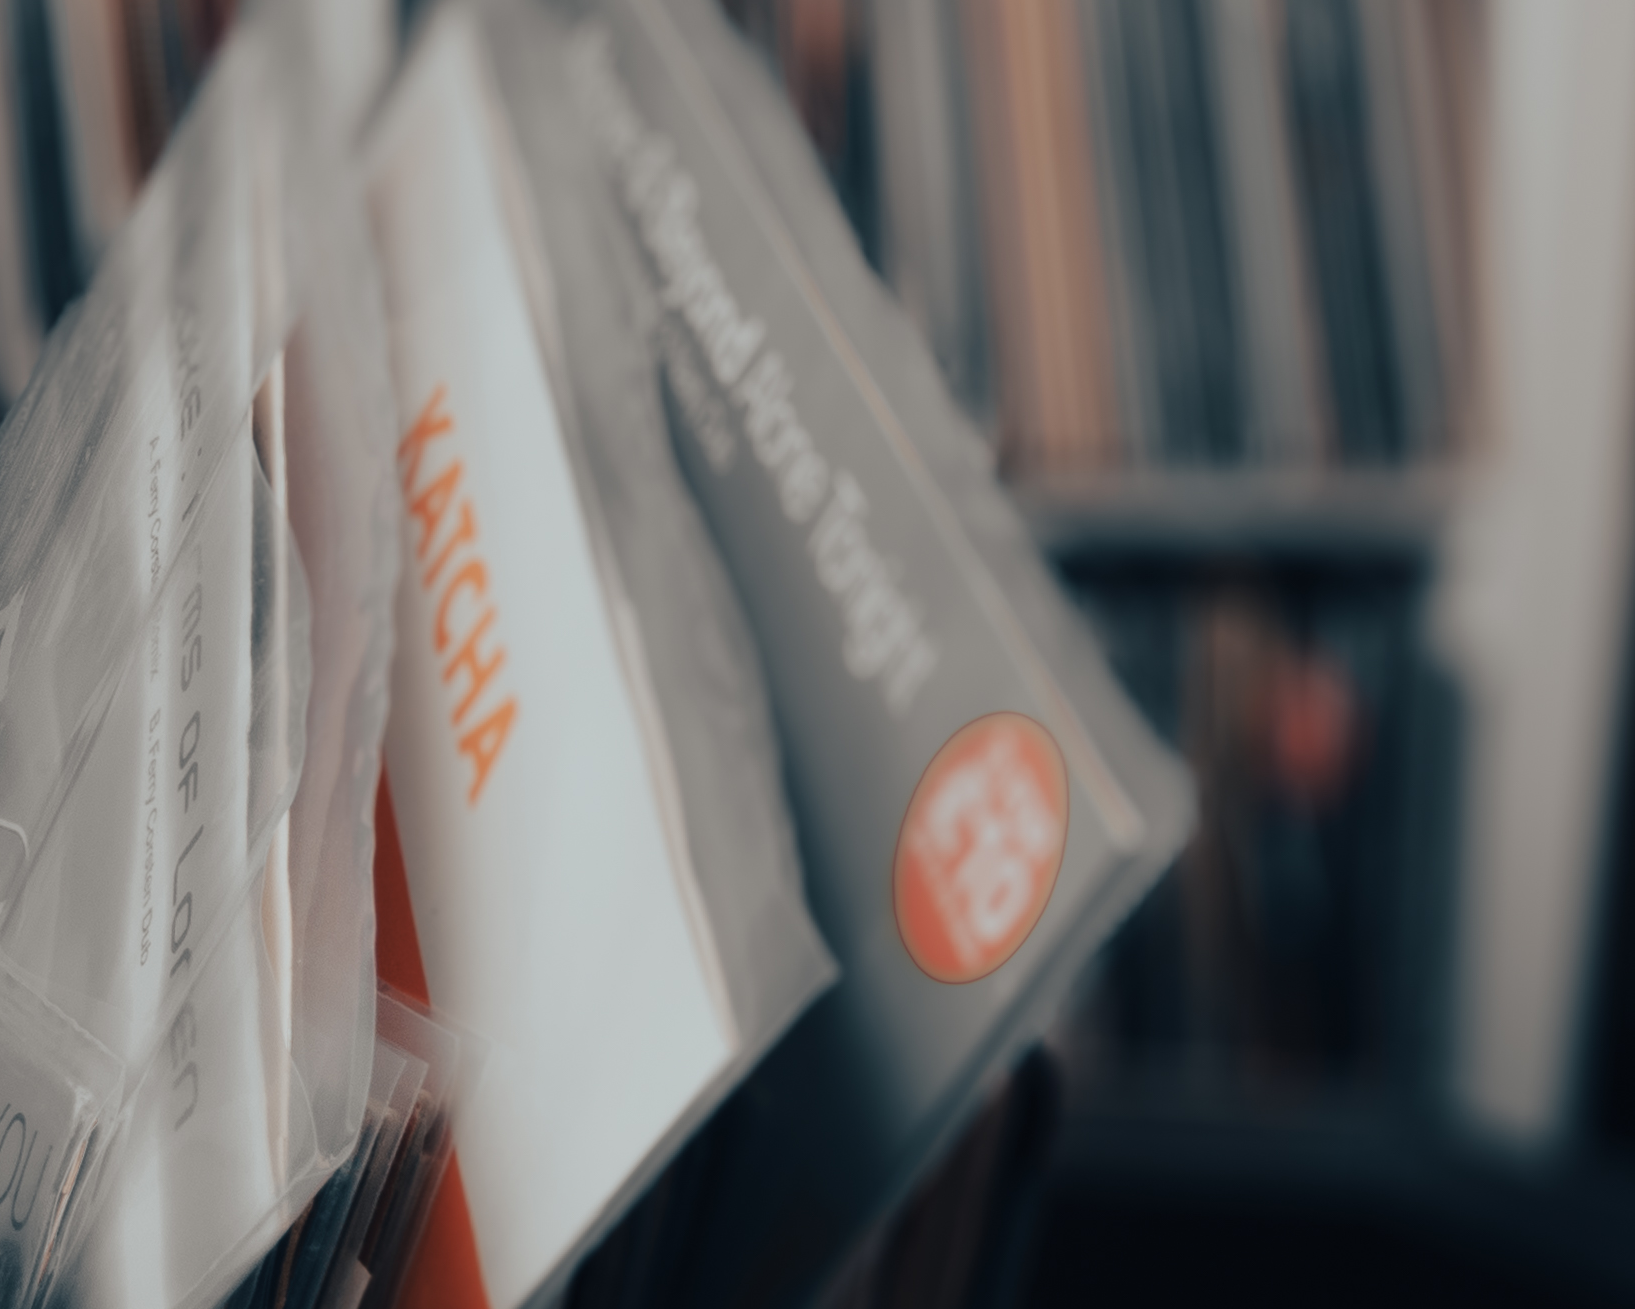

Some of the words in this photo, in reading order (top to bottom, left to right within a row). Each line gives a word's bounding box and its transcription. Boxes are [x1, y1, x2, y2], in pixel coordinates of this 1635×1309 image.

[397, 382, 518, 808] KATCHA
[145, 739, 160, 806] Ferry
[178, 710, 201, 814] OF
[143, 807, 158, 909] Corsten
[140, 907, 153, 967] Dub
